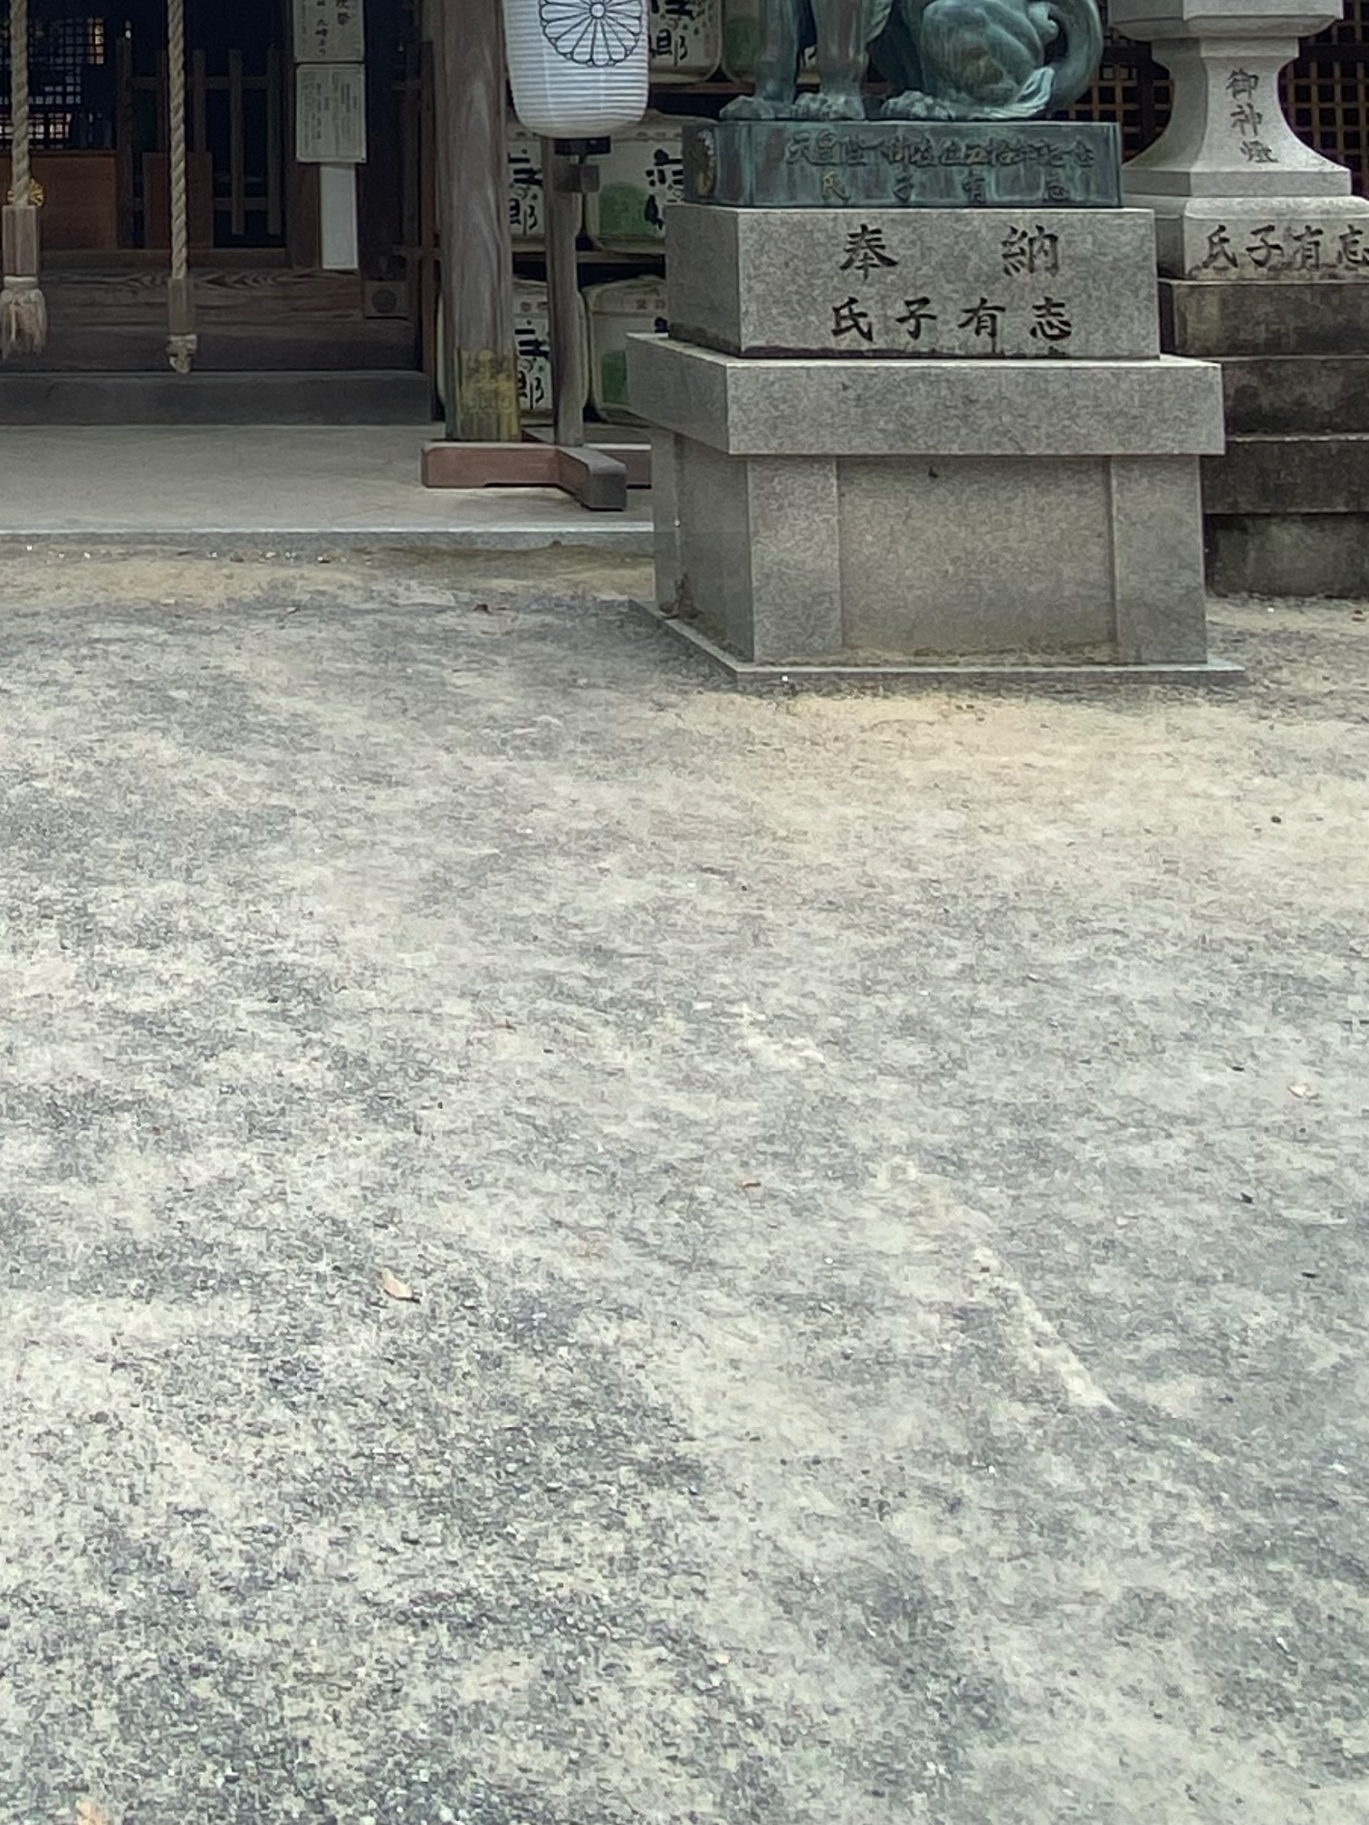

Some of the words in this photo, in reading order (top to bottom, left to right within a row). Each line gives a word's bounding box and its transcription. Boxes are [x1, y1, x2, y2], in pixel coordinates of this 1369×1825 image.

[1225, 67, 1279, 164] 御神燈
[839, 223, 1061, 280] 奉納
[1200, 223, 1369, 270] 氏子有志
[830, 296, 1073, 343] 氏子有志
